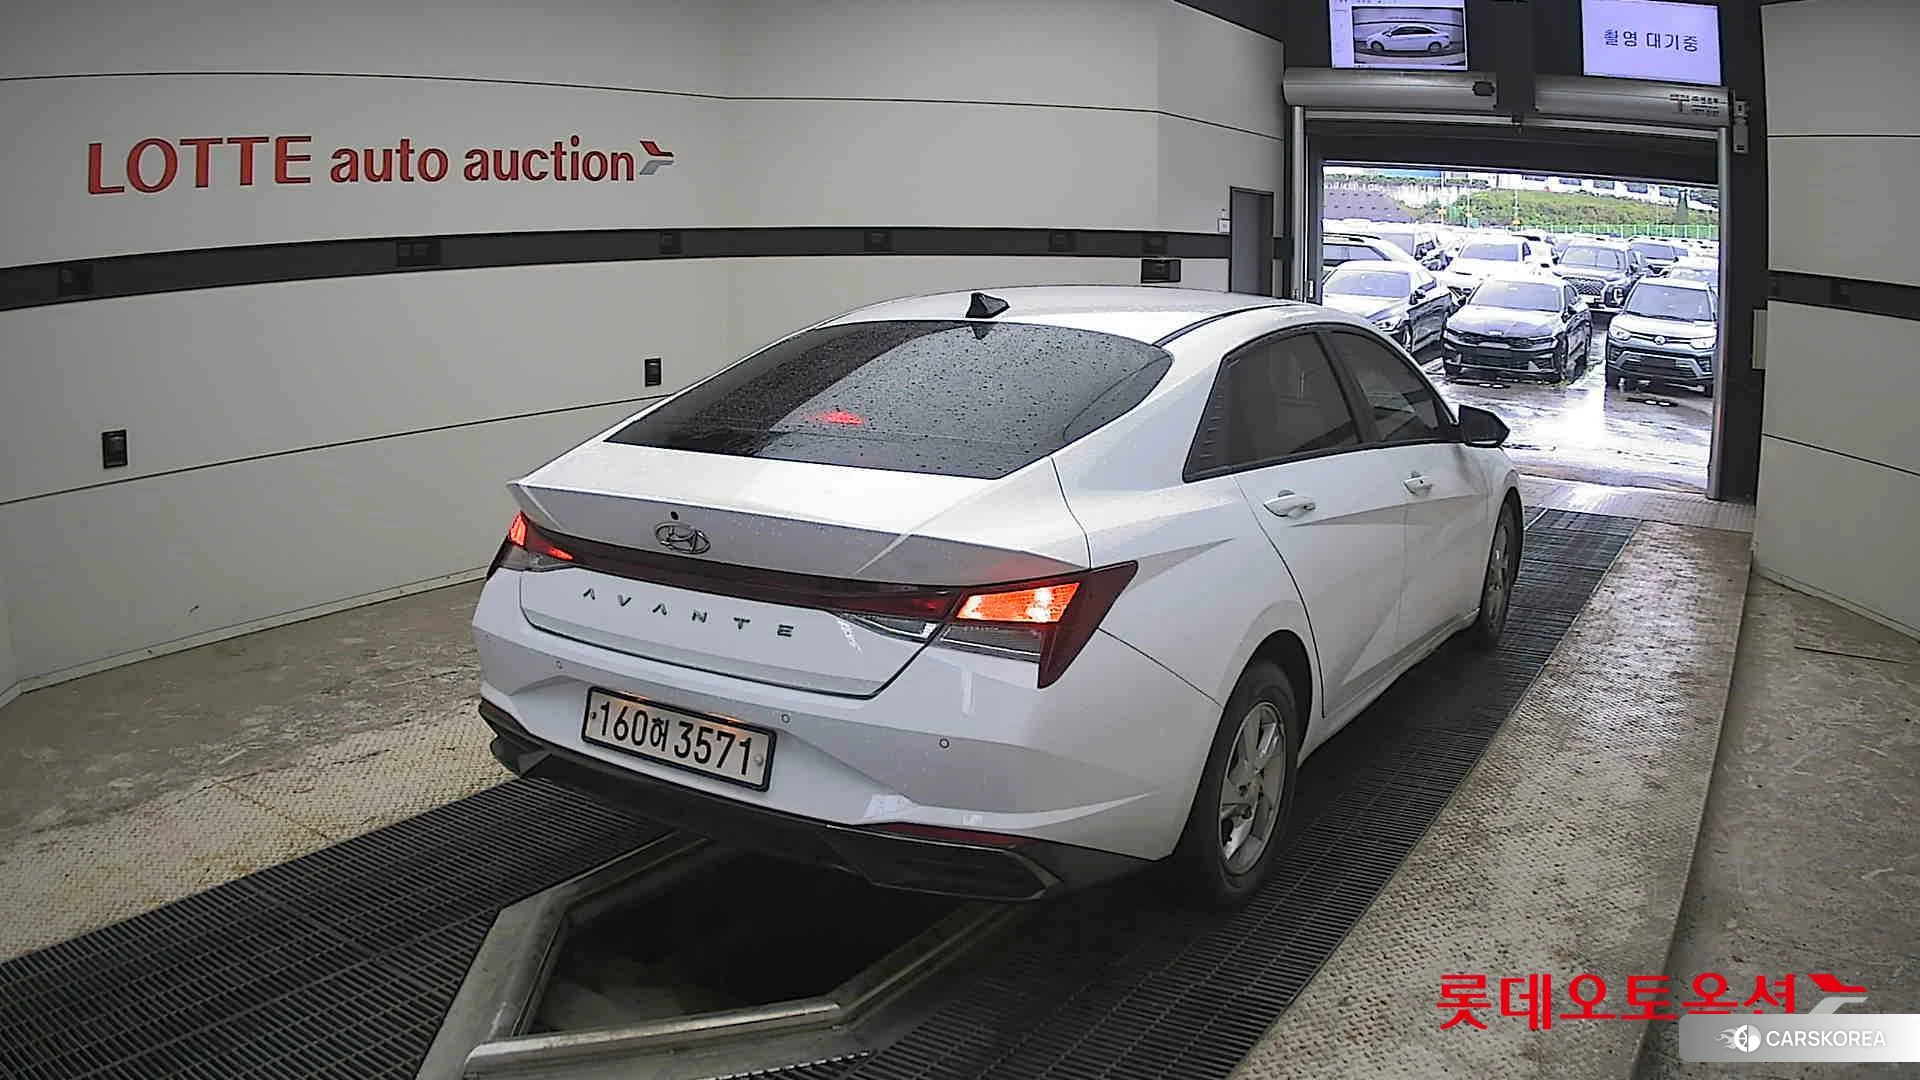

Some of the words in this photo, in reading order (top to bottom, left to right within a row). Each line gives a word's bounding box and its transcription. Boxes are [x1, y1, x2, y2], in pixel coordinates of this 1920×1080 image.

[1646, 32, 1698, 52] 대기중
[87, 135, 312, 195] LOTTE
[330, 138, 449, 184] auto
[463, 135, 635, 182] auction
[583, 587, 794, 638] AVANTE
